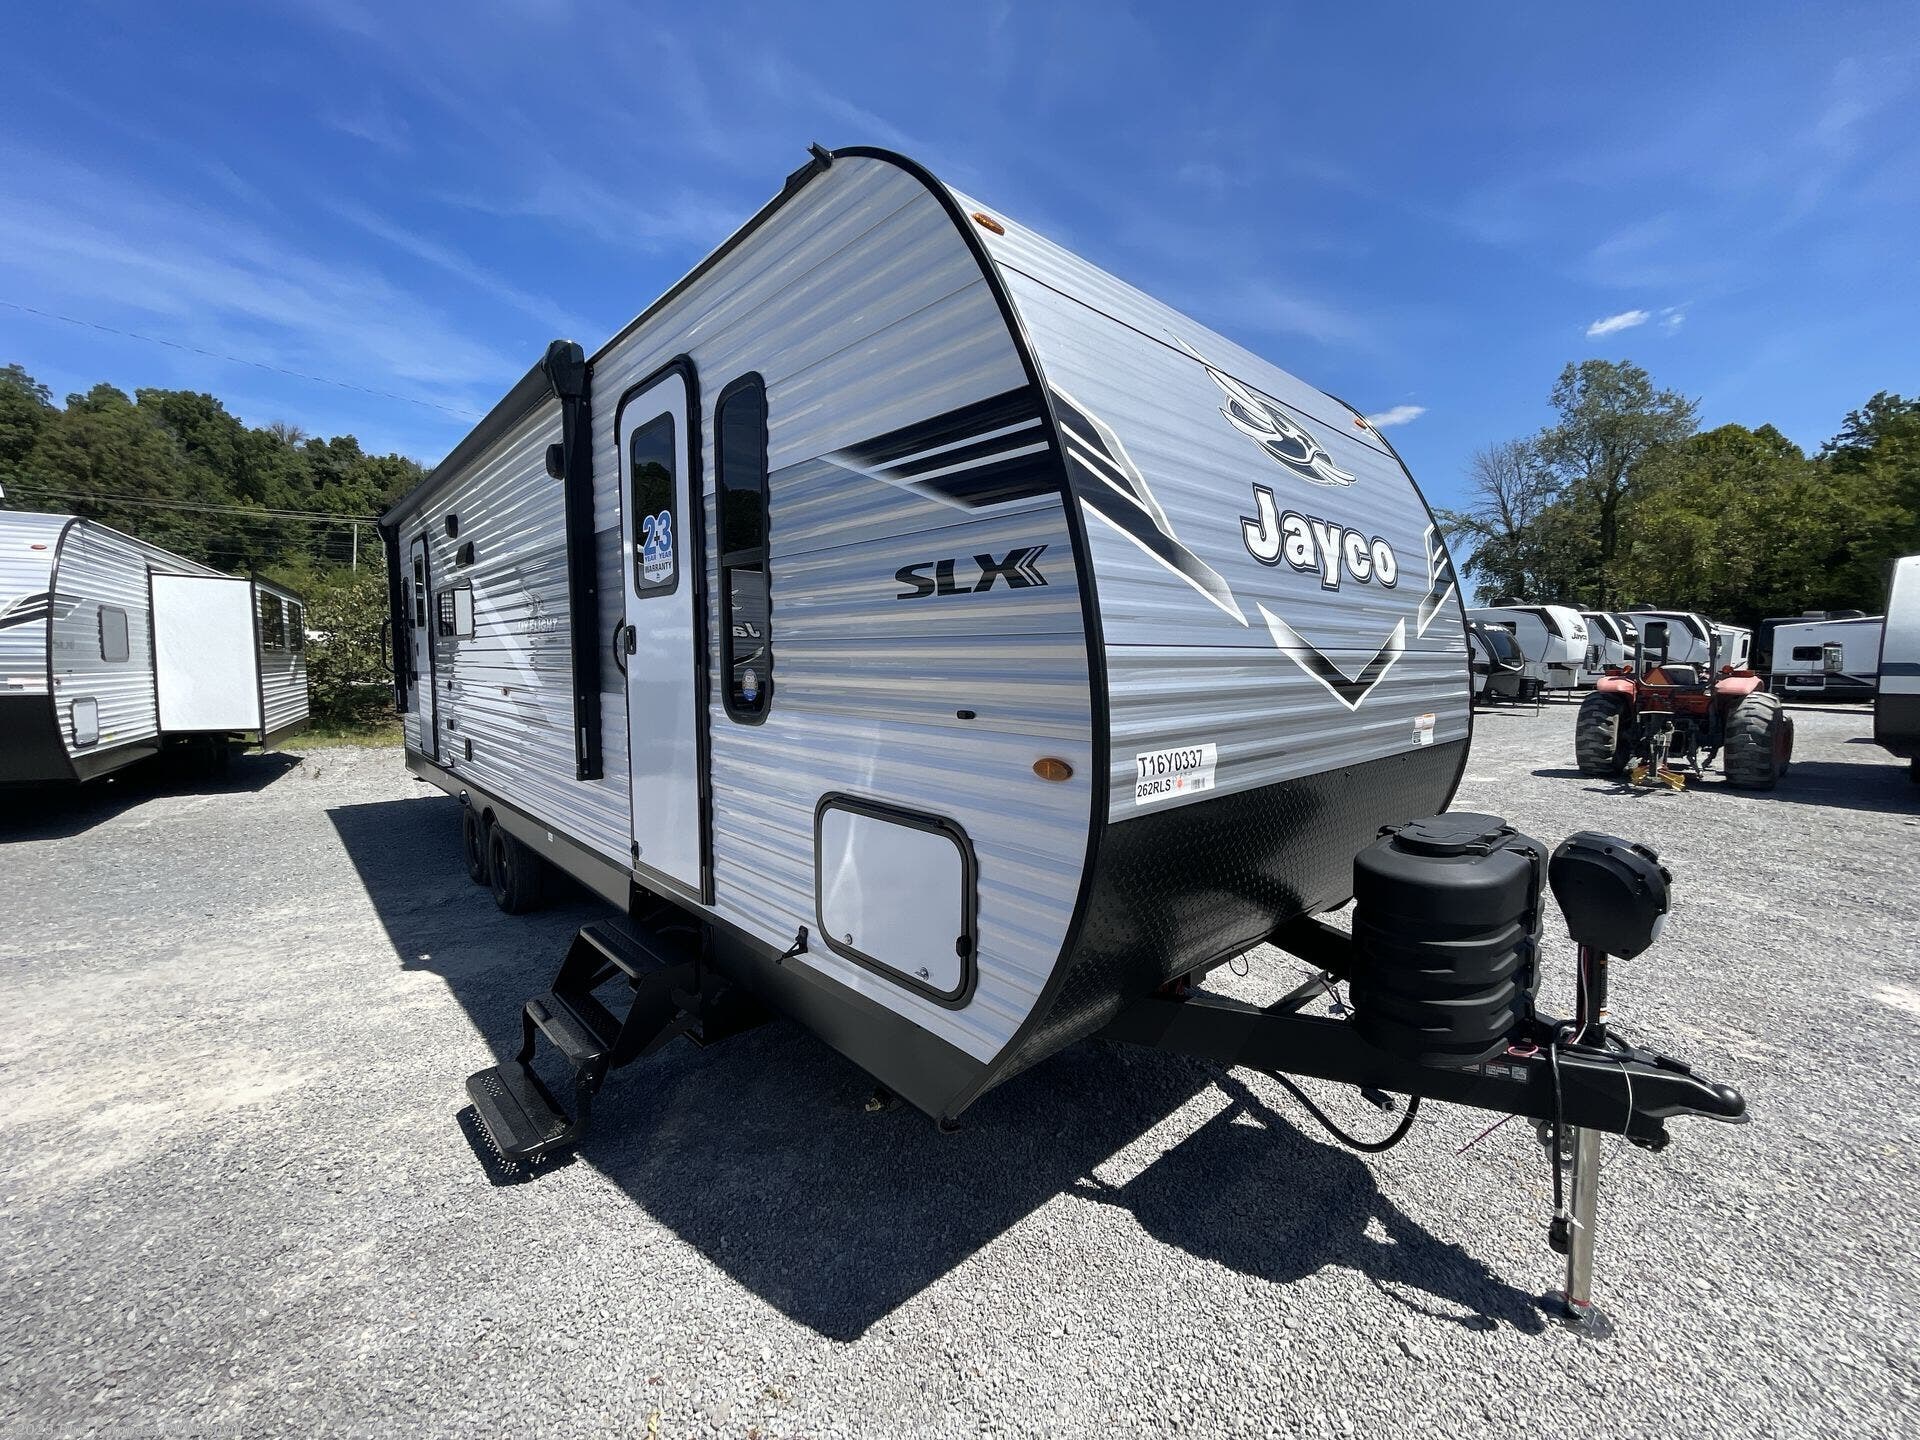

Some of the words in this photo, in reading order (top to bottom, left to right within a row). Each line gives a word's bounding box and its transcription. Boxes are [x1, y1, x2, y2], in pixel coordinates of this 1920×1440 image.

[1240, 482, 1399, 593] Jayco
[660, 551, 671, 559] YEAR
[645, 561, 672, 574] WARRANTY
[895, 544, 1049, 600] SLX
[1138, 749, 1202, 777] T16Y0337
[1137, 779, 1171, 797] 262RLS
